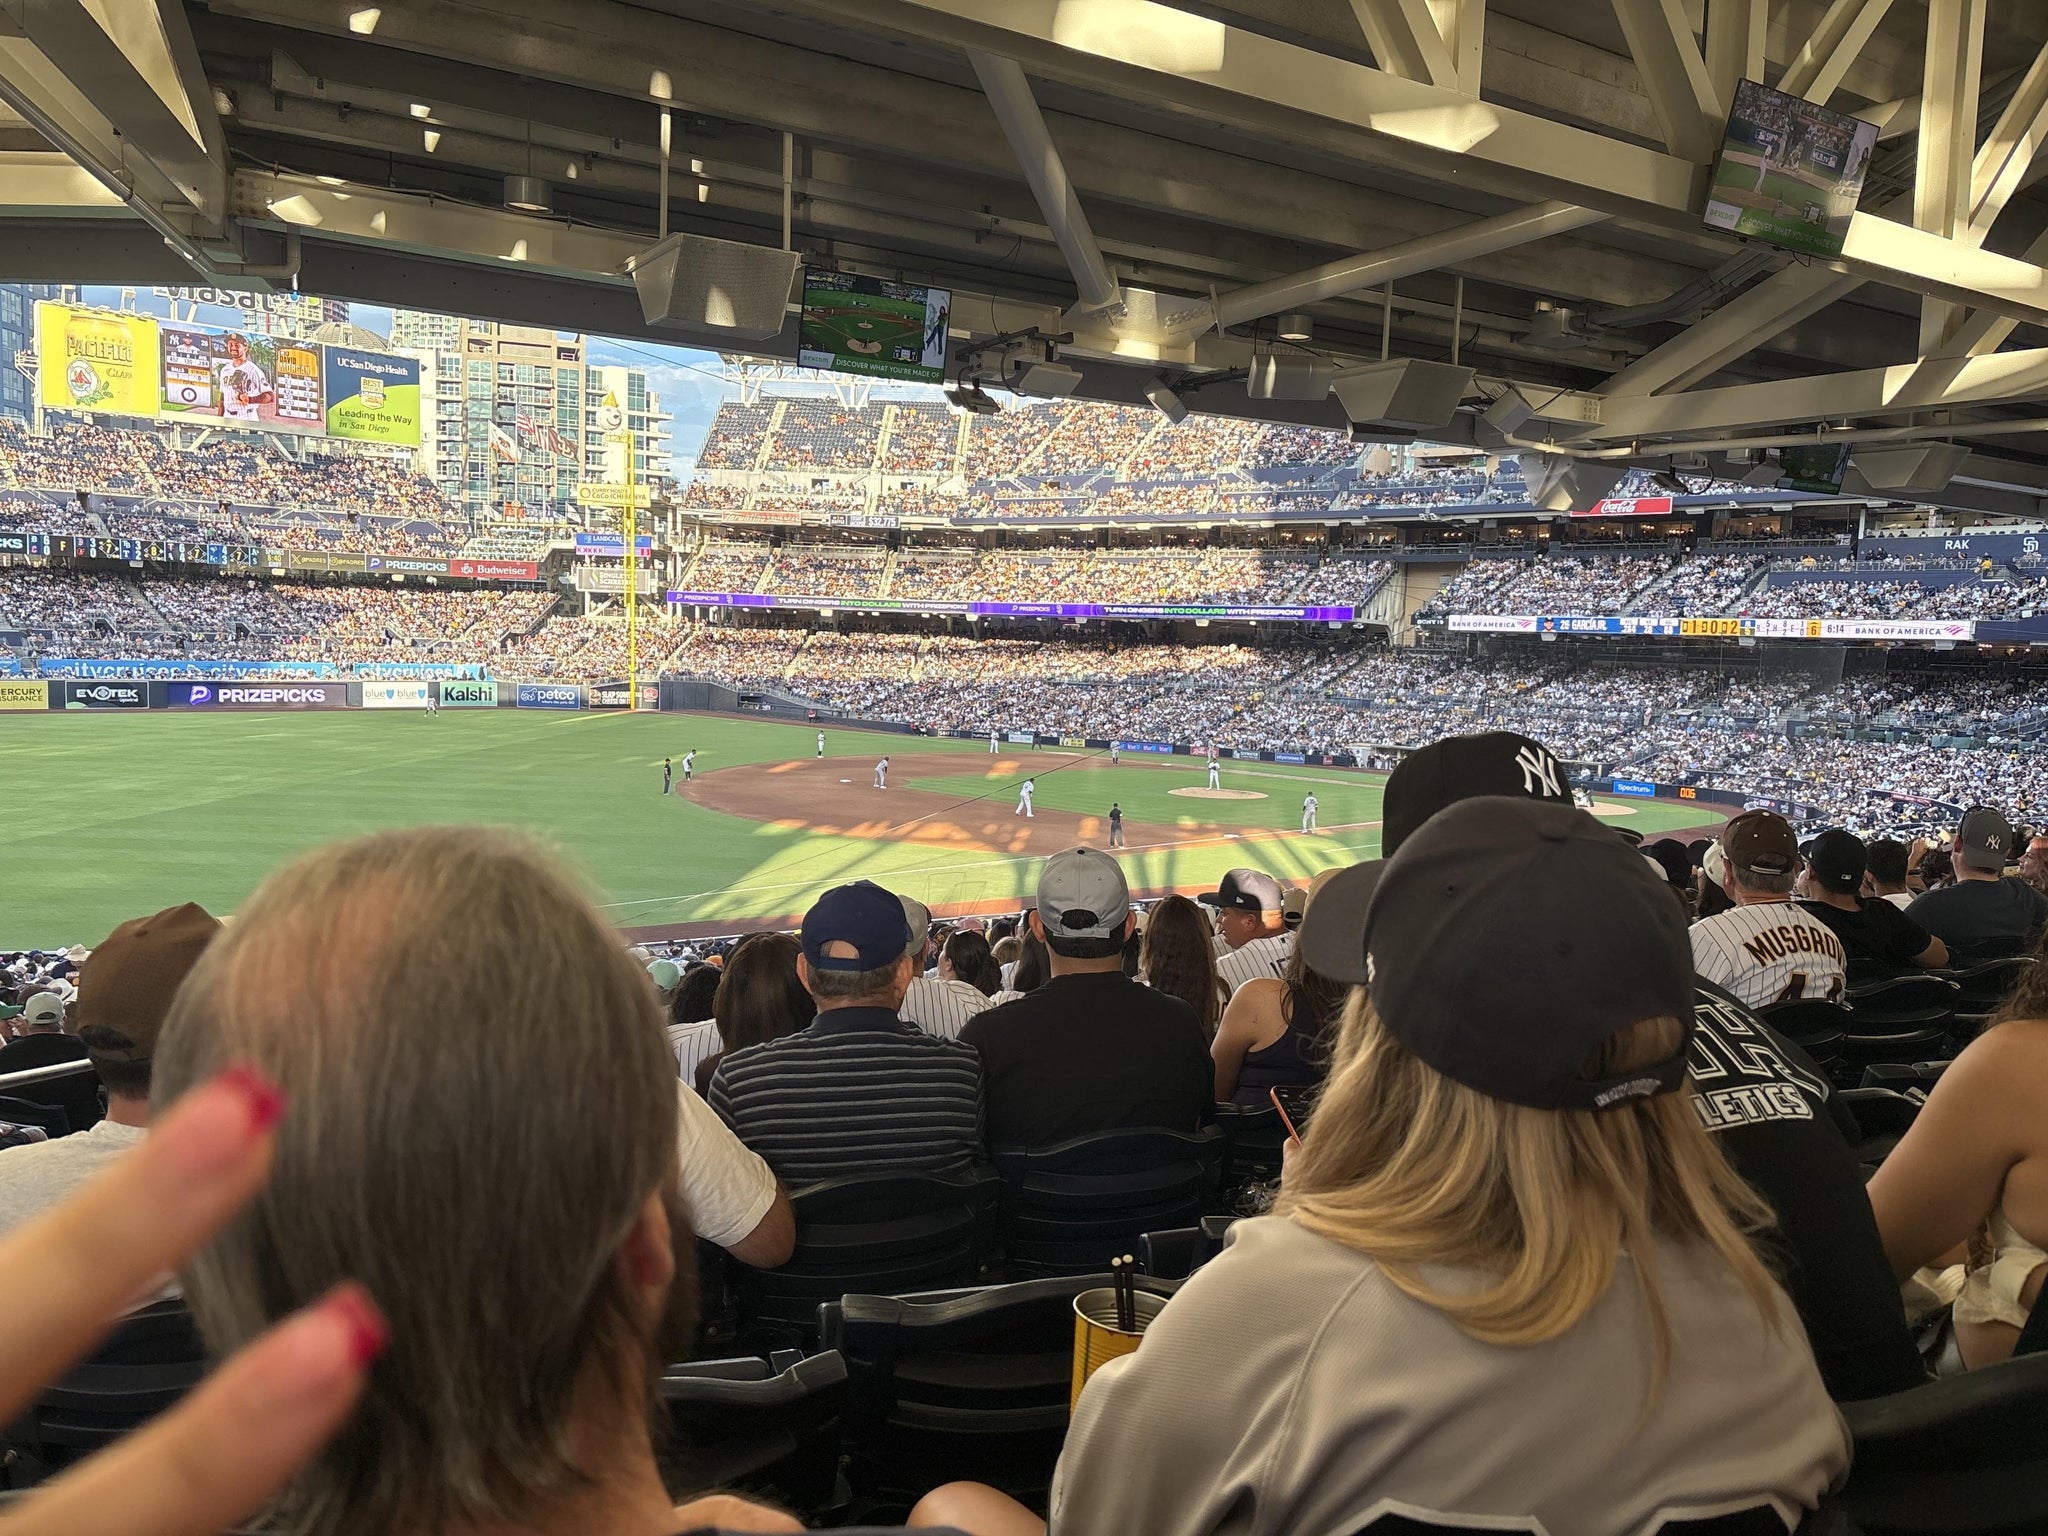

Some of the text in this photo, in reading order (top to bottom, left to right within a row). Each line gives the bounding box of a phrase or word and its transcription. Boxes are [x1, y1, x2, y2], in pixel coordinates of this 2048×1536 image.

[337, 357, 409, 376] UC San Diego Health
[836, 358, 940, 379] DISCOVER WHAT YOU'RE MADE OF
[339, 408, 412, 426] Leading the Way
[339, 420, 391, 434] in San Diego
[60, 541, 67, 551] F
[89, 538, 96, 547] 3
[135, 541, 141, 550] 3
[1945, 539, 1970, 550] RAK
[106, 543, 112, 554] 7
[195, 548, 200, 558] 7
[135, 551, 141, 560] 2
[385, 560, 447, 572] PRIZEPICKS
[477, 564, 519, 576] Budweiser
[778, 597, 803, 605] TURN
[1731, 620, 1738, 634] 2
[1811, 625, 1817, 635] 6
[1827, 624, 1845, 634] 6:14
[1897, 628, 1941, 636] AMERICA
[0, 688, 43, 697] ERCURY
[77, 686, 139, 701] EVOTEK
[218, 688, 326, 703] PRIZEPICKS
[365, 689, 386, 698] blue
[397, 689, 417, 698] blue
[445, 686, 492, 702] Kalshi
[538, 690, 576, 703] petco
[1515, 745, 1562, 797] NY
[1617, 783, 1648, 794] Spectrum
[1986, 834, 2001, 850] NY
[1743, 924, 1847, 968] MUSGROV
[1690, 1081, 1813, 1132] LETICS
